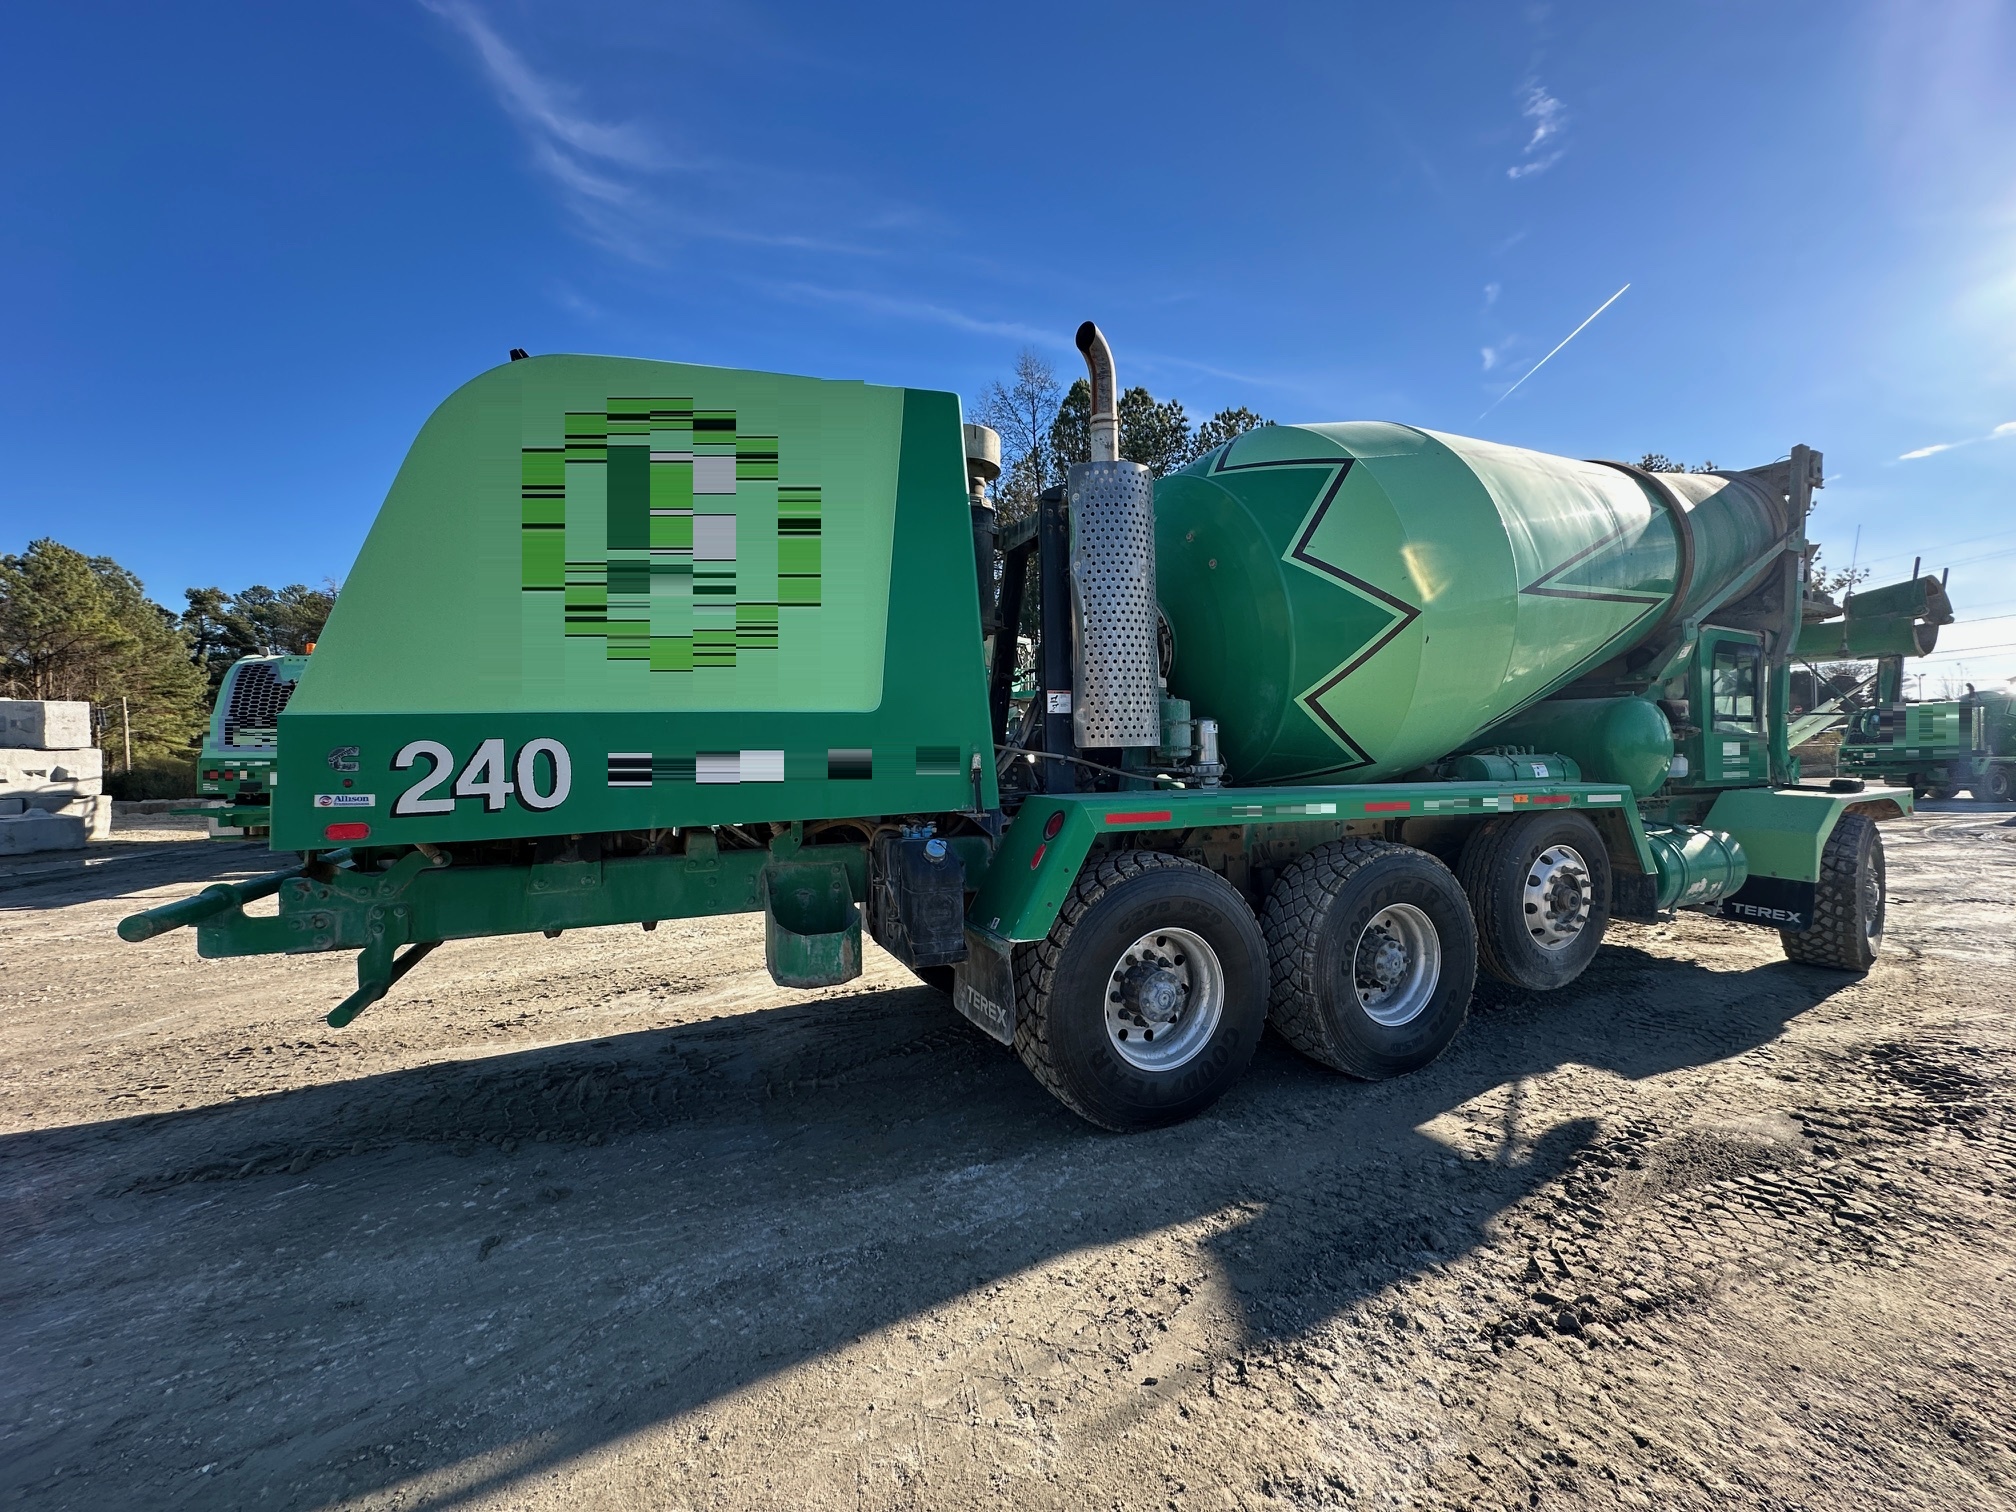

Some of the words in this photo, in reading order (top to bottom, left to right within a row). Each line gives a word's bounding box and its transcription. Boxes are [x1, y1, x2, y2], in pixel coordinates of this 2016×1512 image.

[391, 737, 572, 818] 240
[1732, 902, 1802, 923] TEREX
[967, 985, 1007, 1028] TEREX
